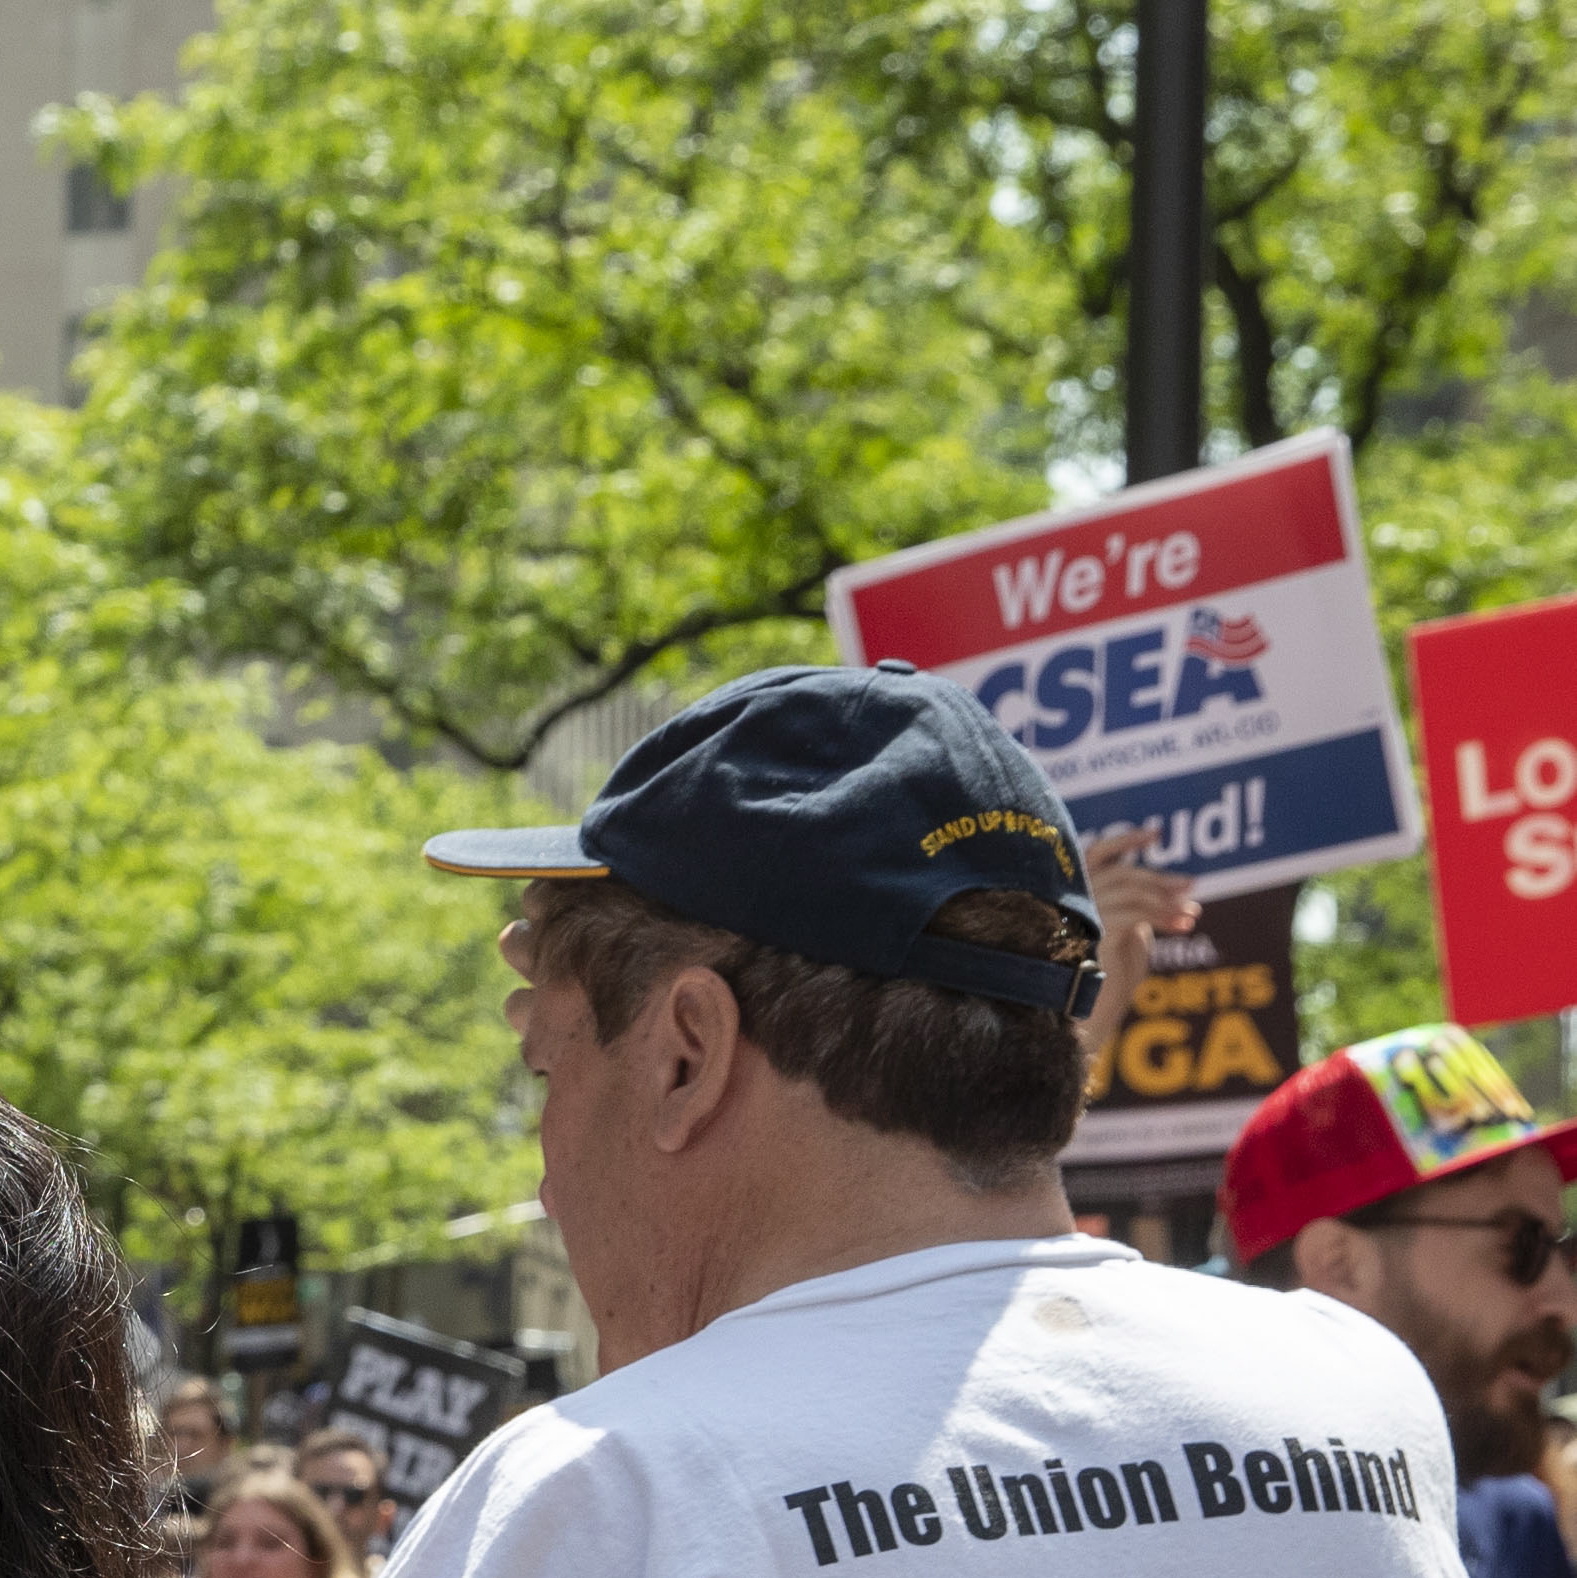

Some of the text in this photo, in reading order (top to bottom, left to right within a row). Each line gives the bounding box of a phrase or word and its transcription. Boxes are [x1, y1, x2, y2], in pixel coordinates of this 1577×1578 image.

[992, 529, 1201, 632] We're
[976, 810, 1004, 833] UP
[783, 1435, 1422, 1568] The Union Behind
